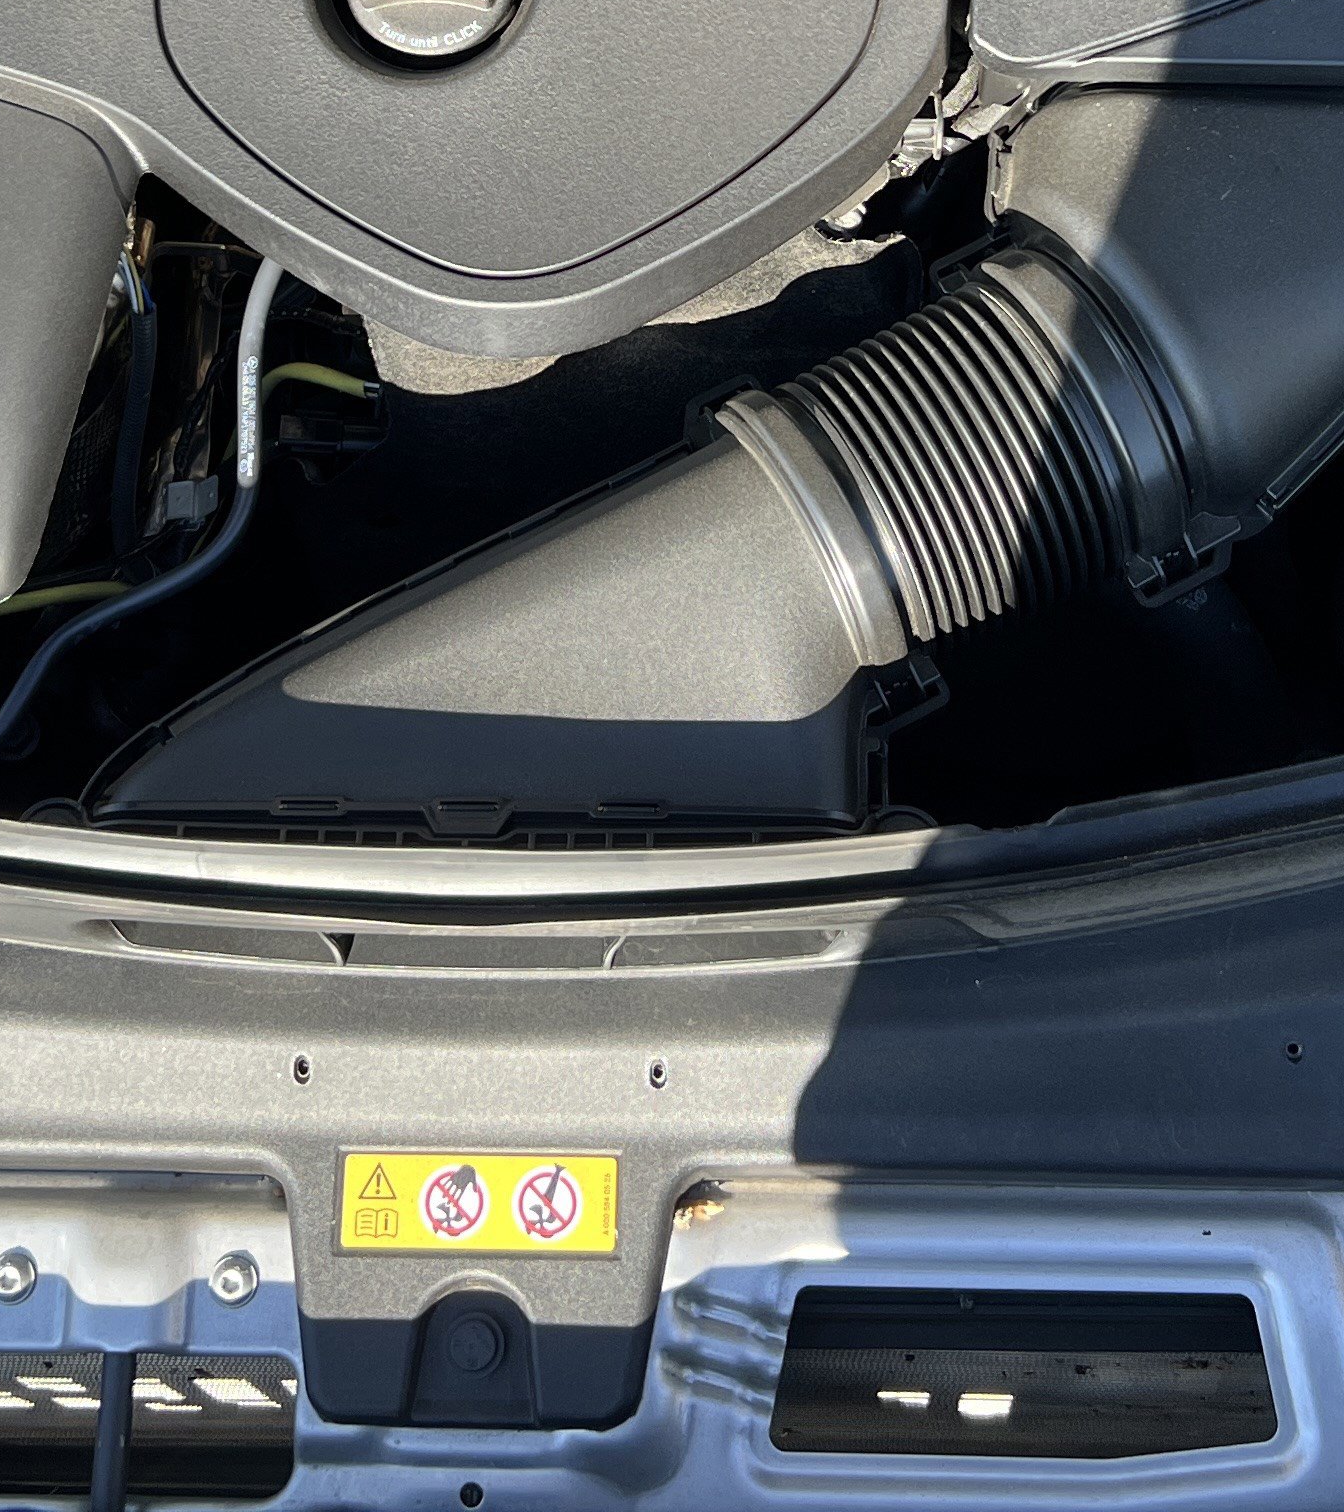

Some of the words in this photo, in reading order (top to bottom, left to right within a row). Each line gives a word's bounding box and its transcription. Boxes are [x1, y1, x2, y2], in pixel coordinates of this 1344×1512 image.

[378, 21, 406, 44] Turn
[410, 36, 438, 48] until
[443, 19, 483, 45] CLICK
